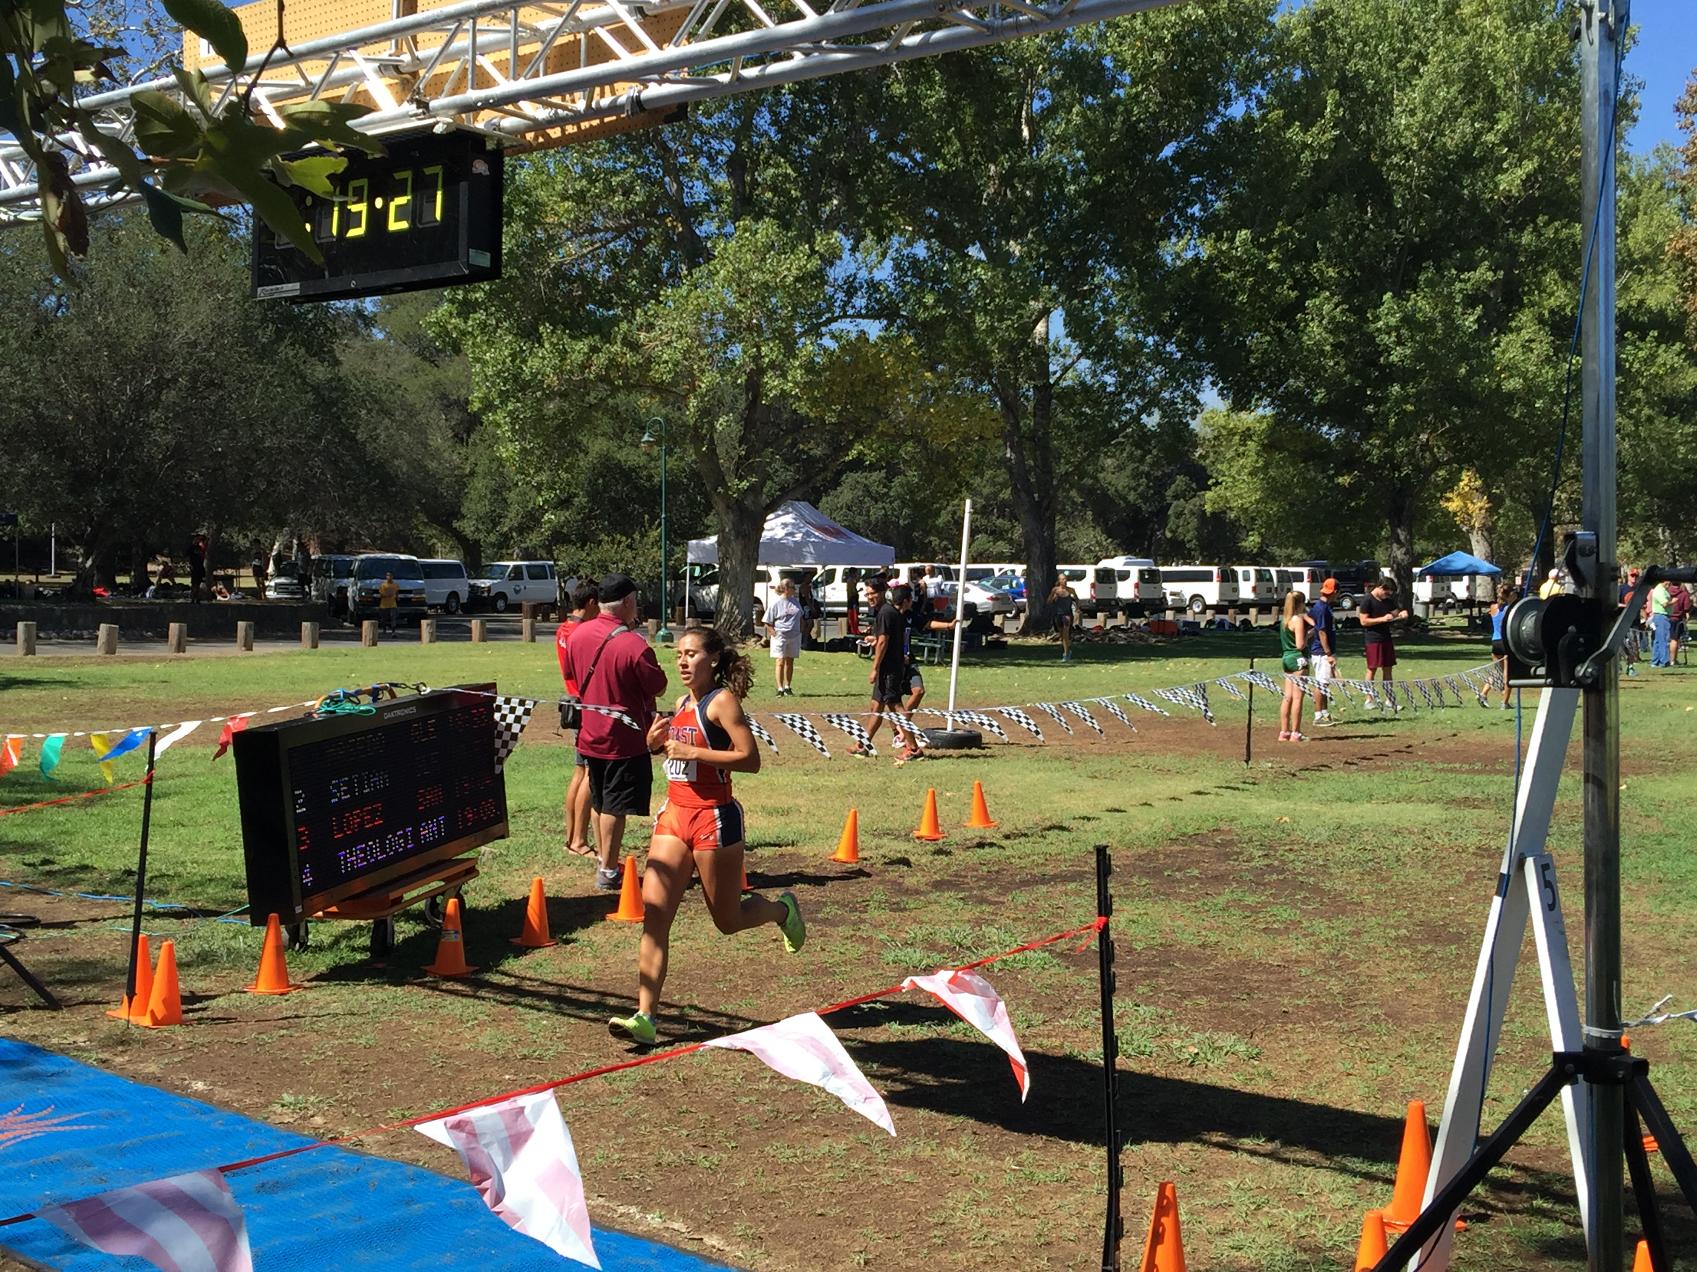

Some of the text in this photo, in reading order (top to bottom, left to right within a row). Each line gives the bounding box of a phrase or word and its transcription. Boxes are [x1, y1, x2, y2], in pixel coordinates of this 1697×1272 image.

[668, 759, 690, 776] 202
[296, 801, 386, 852] 3 LOPEZ
[302, 863, 314, 887] 4
[1541, 863, 1556, 912] 5
